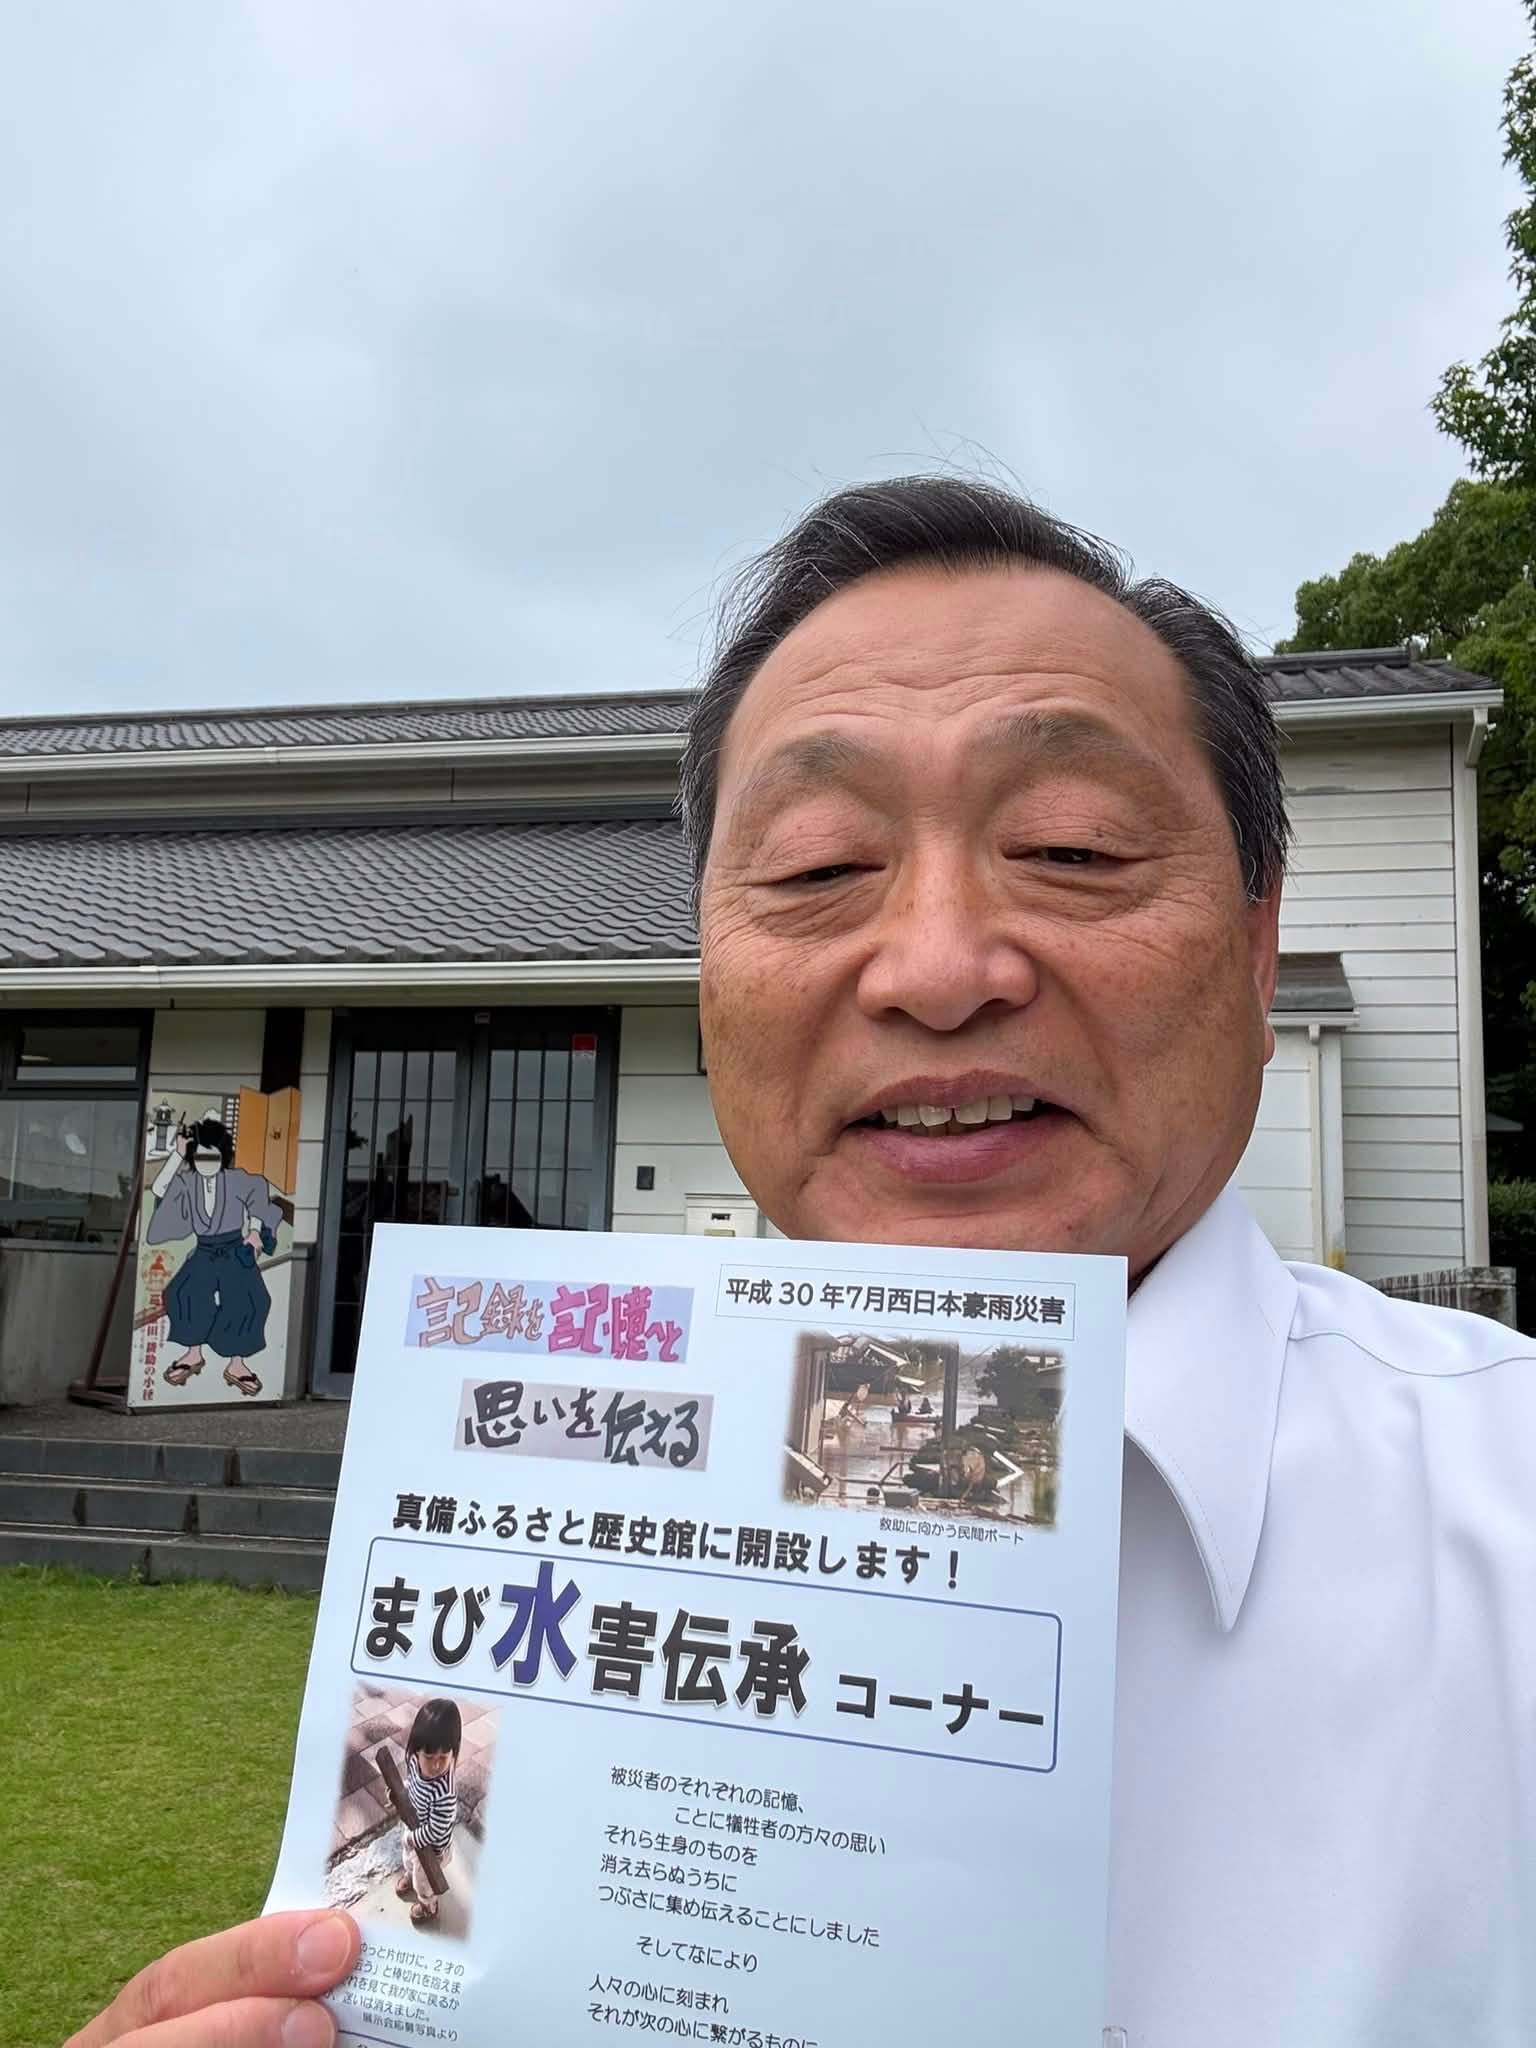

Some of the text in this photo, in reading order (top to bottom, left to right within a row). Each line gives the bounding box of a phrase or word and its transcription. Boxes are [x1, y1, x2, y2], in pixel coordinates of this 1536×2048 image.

[464, 1380, 699, 1467] 思いを伝える
[610, 1766, 805, 1814] 被災者のそれぞれの記憶、
[603, 1824, 758, 1866] それら生身のものを
[675, 1806, 887, 1855] ことに犠牲者の方々の思い
[599, 1853, 737, 1893] 消え去らぬうちに
[598, 1885, 880, 1948] つぶさに集め伝えることにしました
[636, 1936, 758, 1972] そしてなにより
[588, 1973, 729, 2014] 人々の心に刻まれ
